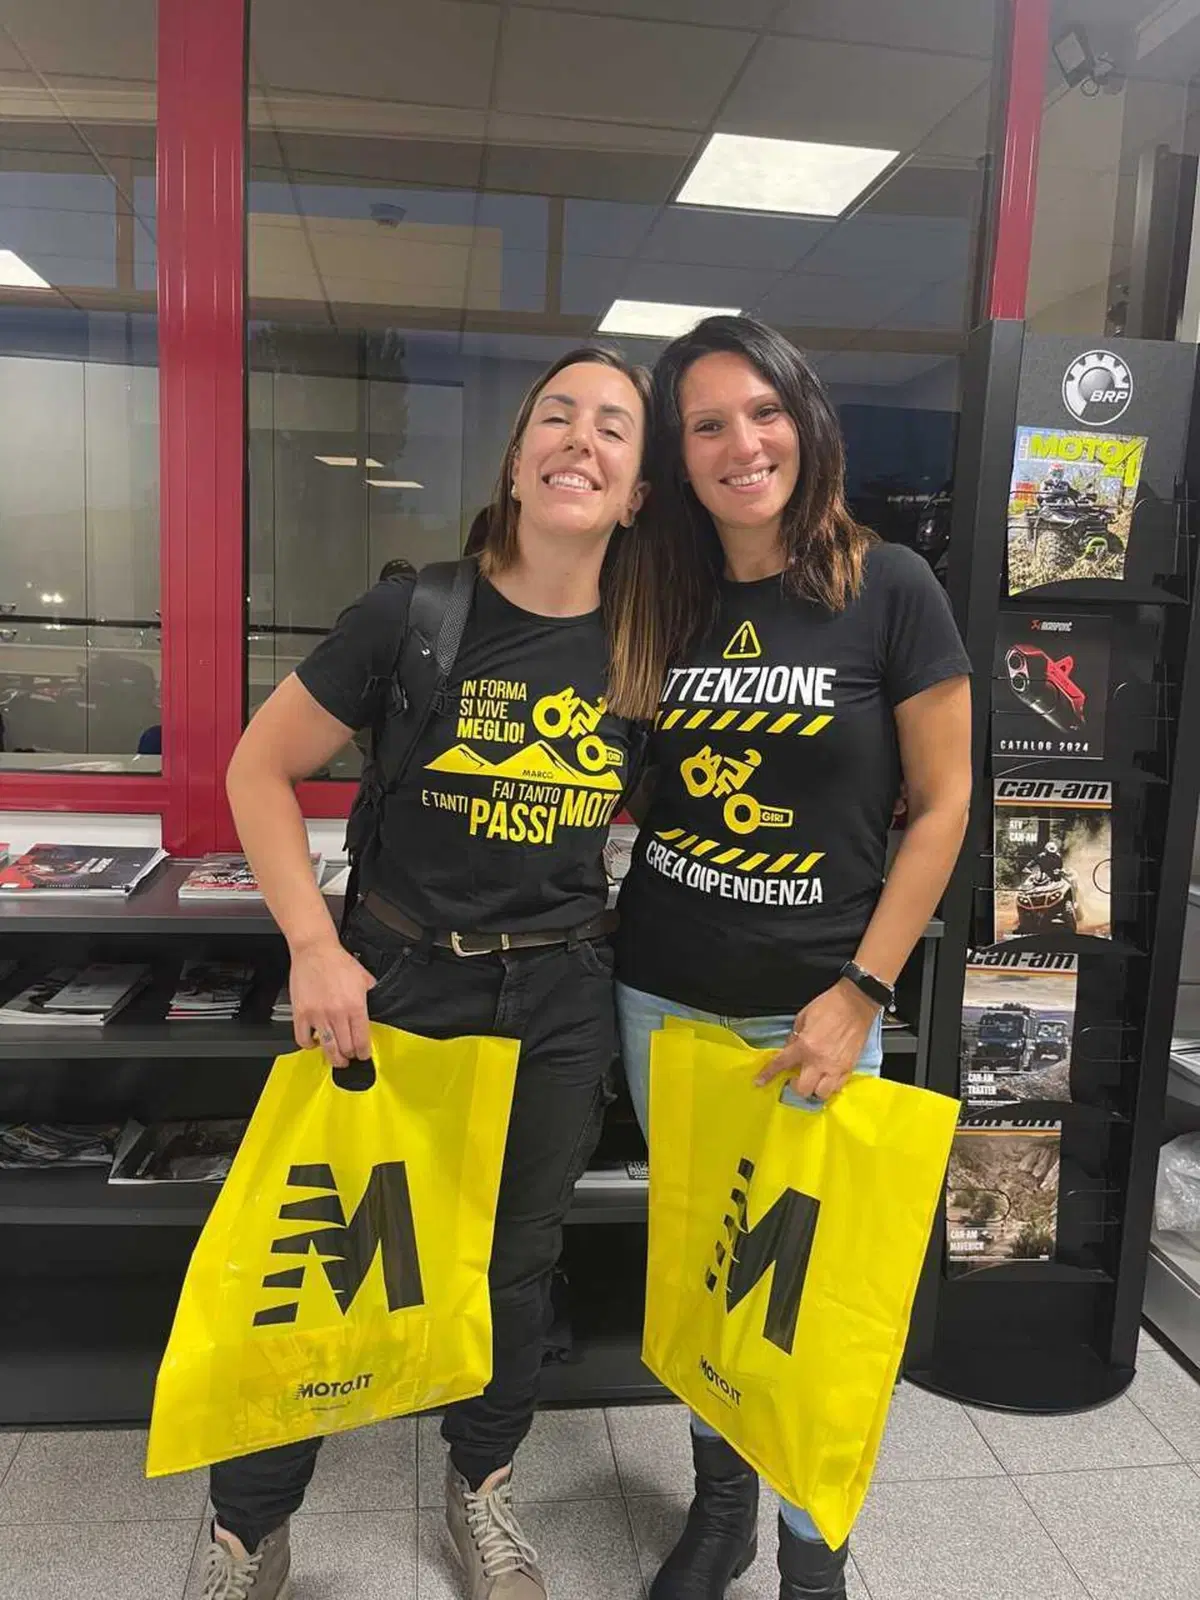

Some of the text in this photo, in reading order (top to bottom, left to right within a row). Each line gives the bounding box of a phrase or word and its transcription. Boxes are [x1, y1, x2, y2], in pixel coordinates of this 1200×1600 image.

[1089, 390, 1128, 403] BRP
[462, 680, 527, 701] IN FORMA
[660, 666, 836, 707] TTENZIONE
[460, 699, 509, 719] SI VIVE
[457, 718, 525, 743] MEGLIO!
[1000, 740, 1089, 752] CATALOG 2024
[522, 769, 554, 779] MARCO
[492, 781, 515, 800] FAI
[519, 783, 561, 804] TANTO
[997, 781, 1109, 800] can-am
[421, 790, 558, 844] E TANTI PASSI
[761, 811, 783, 823] GIRI
[645, 840, 824, 906] CREA DIPENDENZA
[294, 1373, 373, 1400] MOTO.IT
[700, 1354, 741, 1406] MOTO.IT
